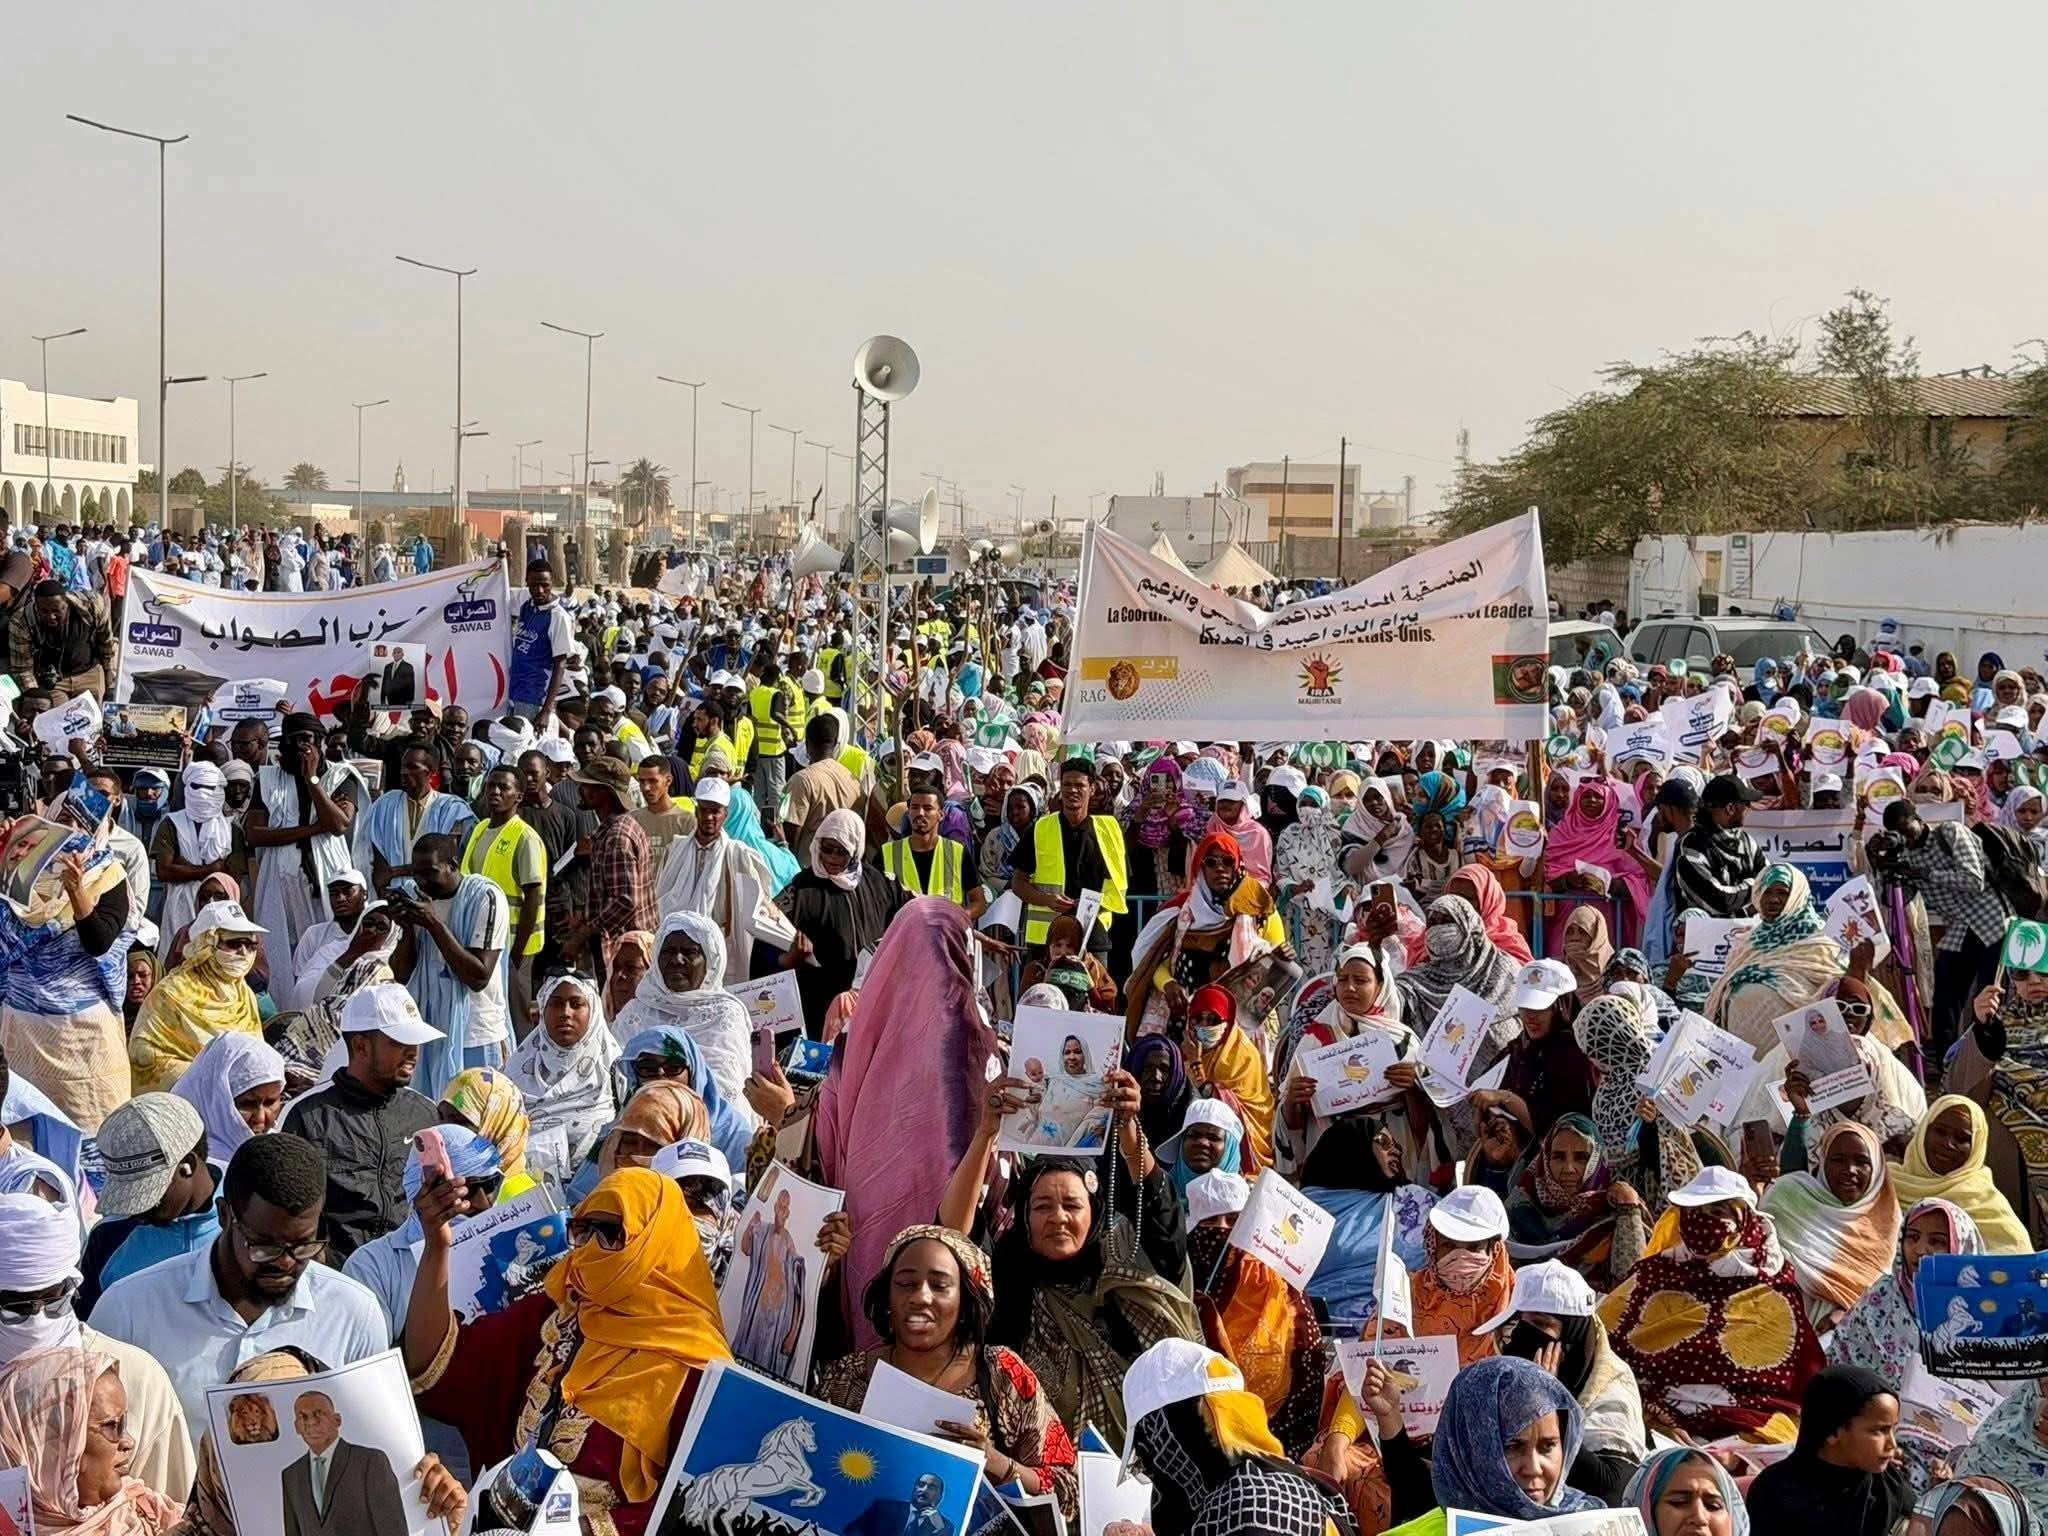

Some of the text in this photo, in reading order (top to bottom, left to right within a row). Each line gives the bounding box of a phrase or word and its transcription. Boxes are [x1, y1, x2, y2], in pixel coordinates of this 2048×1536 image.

[1401, 559, 1484, 603] المنسقية
[1137, 577, 1200, 613] والزعيم
[447, 600, 492, 620] الصواب
[1107, 607, 1119, 623] La
[1484, 603, 1534, 619] Leader
[1273, 603, 1337, 627] الداعم
[131, 627, 178, 642] الصواب
[200, 615, 339, 651] الصواب
[451, 621, 491, 633] SAWAB
[133, 645, 175, 658] SAWAB
[1079, 688, 1106, 703] RAG
[1311, 687, 1330, 696] IRA
[1761, 833, 1844, 858] لصوا
